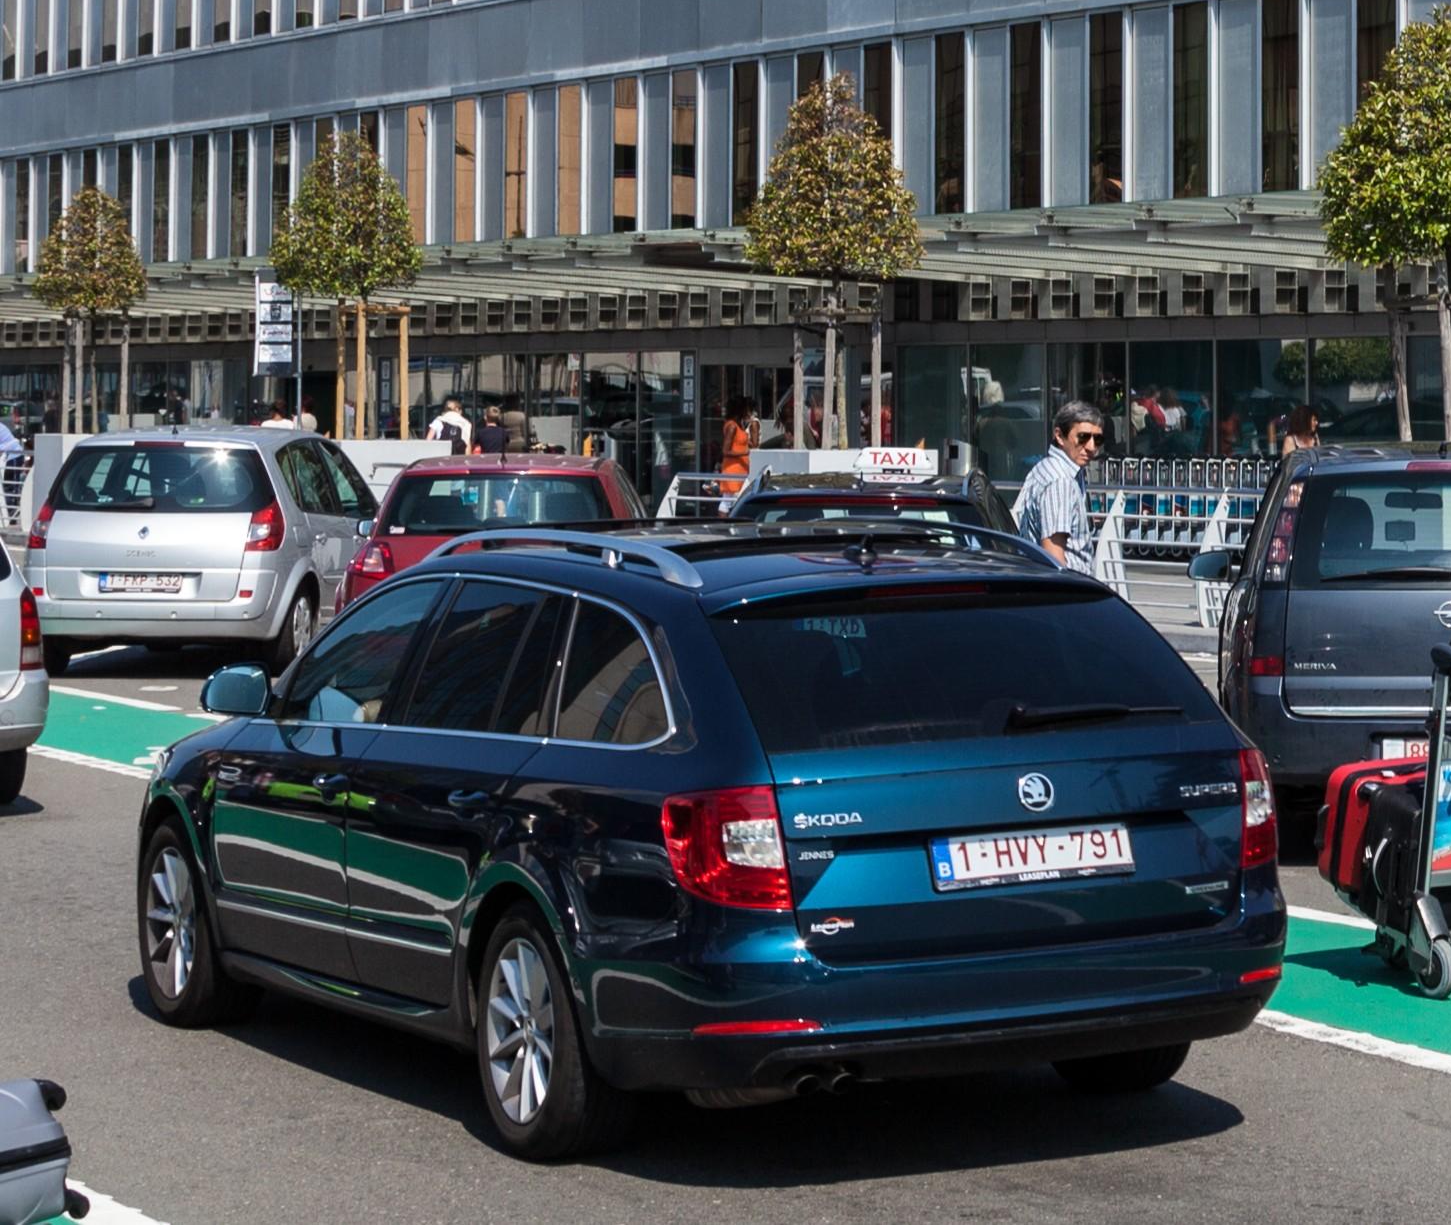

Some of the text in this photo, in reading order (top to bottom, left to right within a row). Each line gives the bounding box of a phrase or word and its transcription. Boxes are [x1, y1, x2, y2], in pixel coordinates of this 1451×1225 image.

[869, 451, 917, 466] TAXI
[1293, 661, 1337, 671] MERIVA
[957, 828, 1123, 872] 1-HVY-791
[938, 862, 952, 878] B
